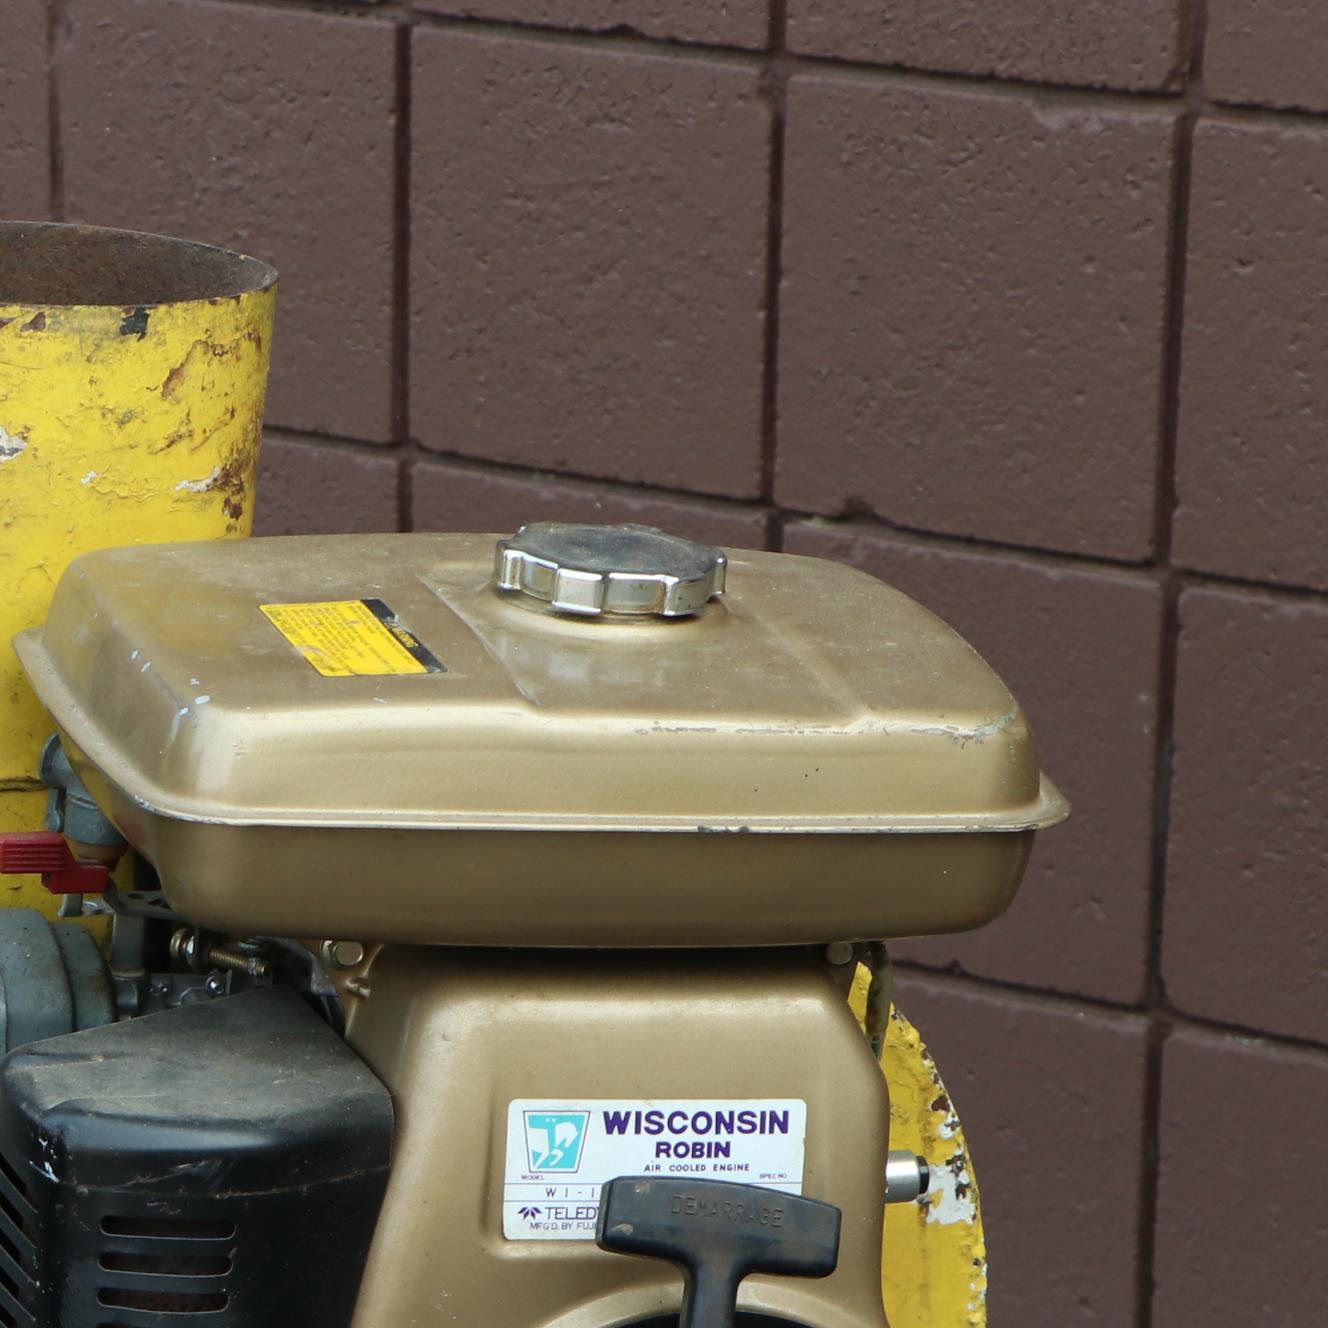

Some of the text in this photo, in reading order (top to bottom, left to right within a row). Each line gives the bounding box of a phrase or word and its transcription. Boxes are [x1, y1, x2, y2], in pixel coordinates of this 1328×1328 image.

[602, 1110, 789, 1136] WISCONSIN
[655, 1141, 731, 1159] ROBIN
[644, 1163, 750, 1173] AIR COOLED ENGINE
[544, 1206, 600, 1220] TELED
[671, 1193, 784, 1228] DEMARRAGE
[561, 1222, 574, 1231] BY
